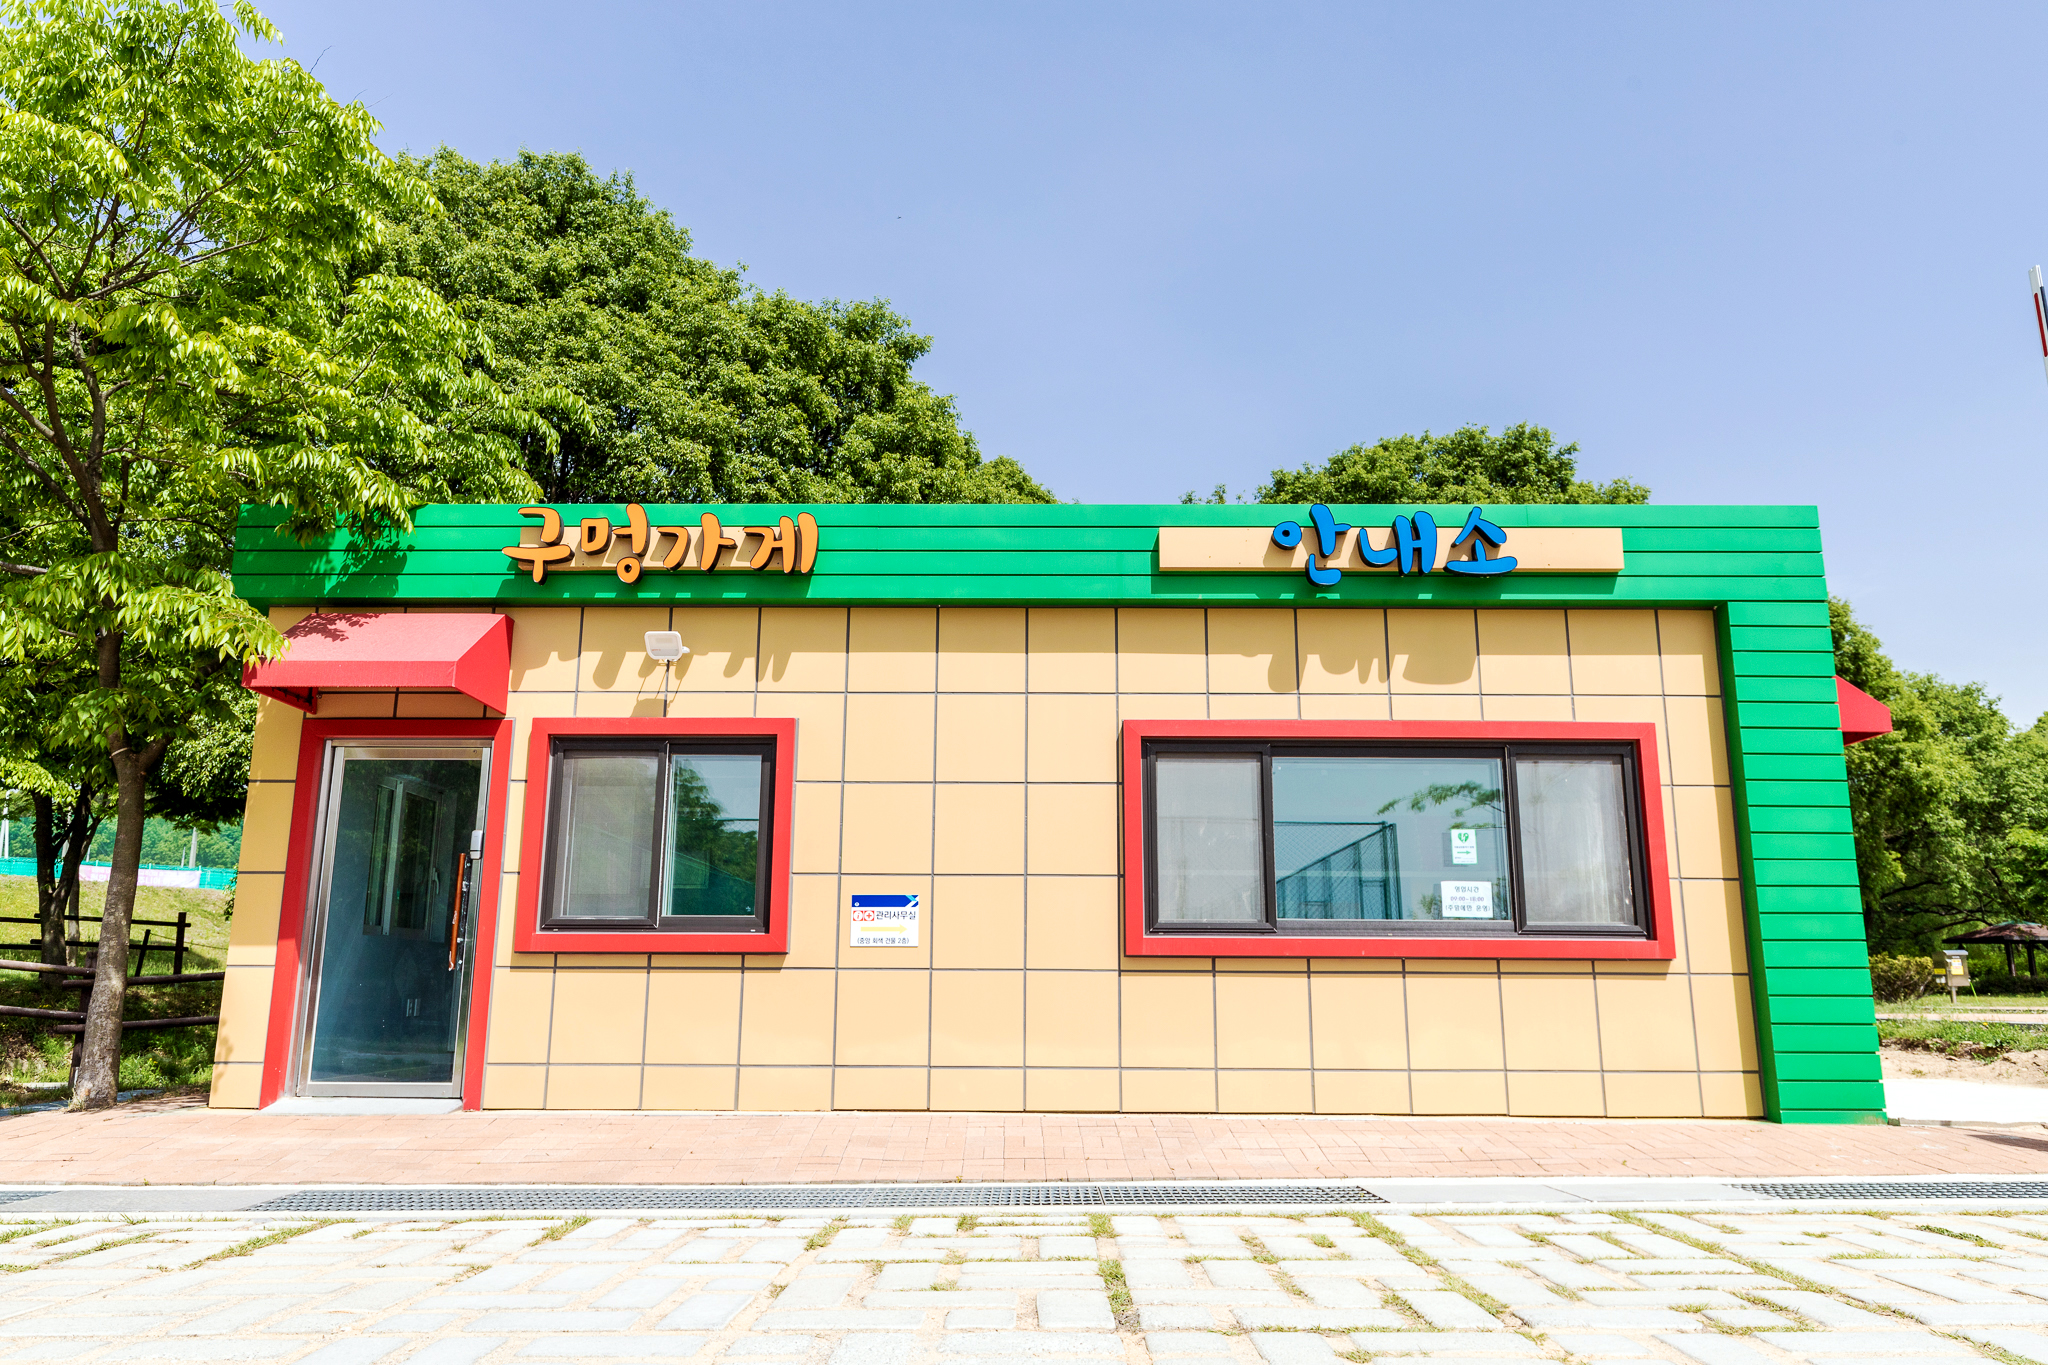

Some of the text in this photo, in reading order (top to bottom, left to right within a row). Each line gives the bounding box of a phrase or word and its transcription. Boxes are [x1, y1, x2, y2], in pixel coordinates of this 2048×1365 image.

[501, 503, 818, 585] 구멍가게
[1271, 503, 1518, 587] 안내소
[876, 911, 916, 920] 관리사무실
